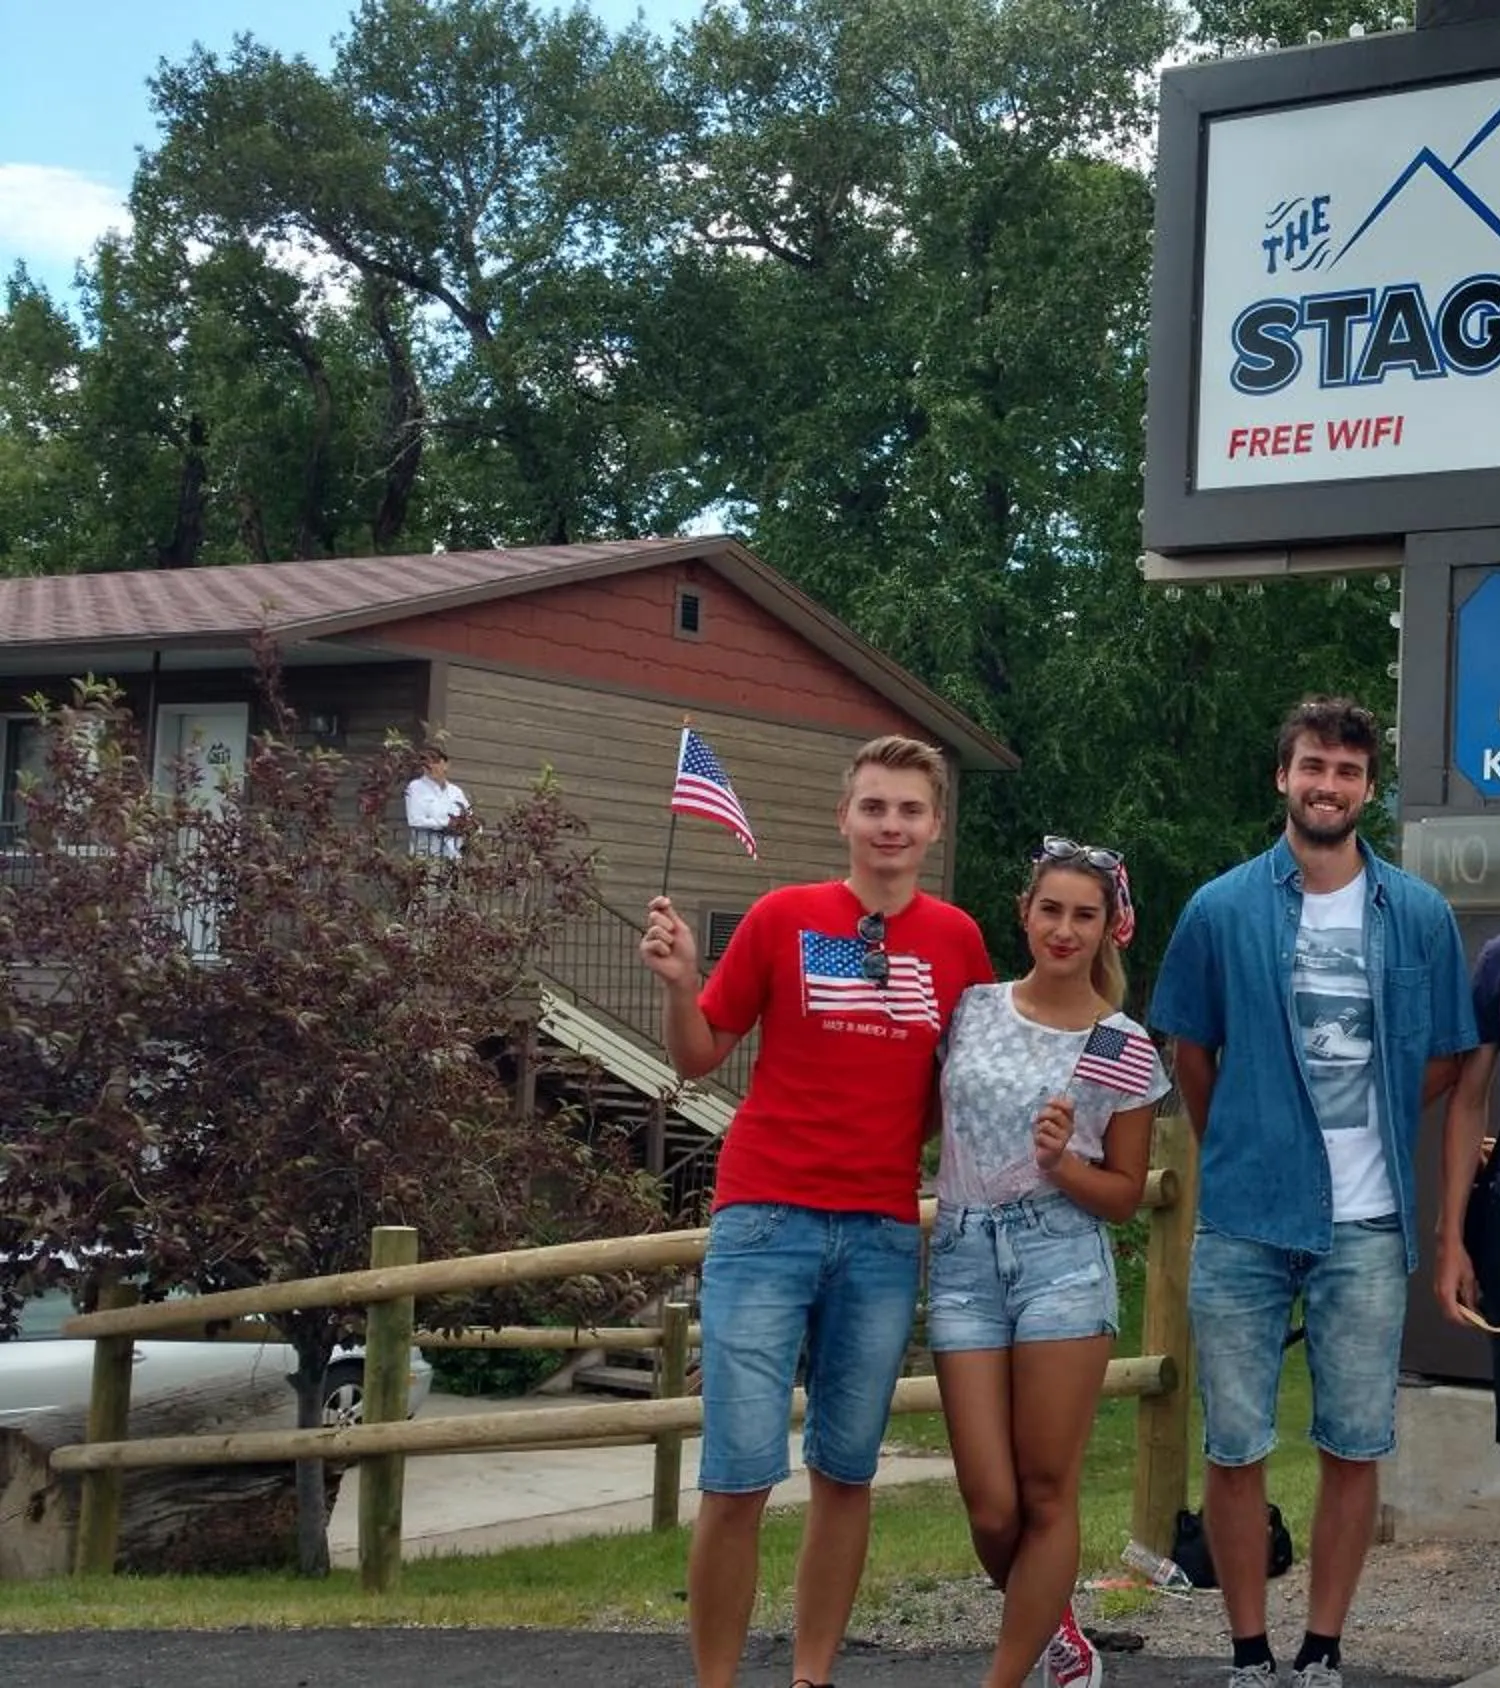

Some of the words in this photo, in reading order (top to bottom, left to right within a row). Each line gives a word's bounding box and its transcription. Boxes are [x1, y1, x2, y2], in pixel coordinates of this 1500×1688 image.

[1262, 195, 1330, 274] THE
[1227, 423, 1315, 459] FREE
[1327, 416, 1404, 451] WIFI
[1434, 835, 1488, 884] NO
